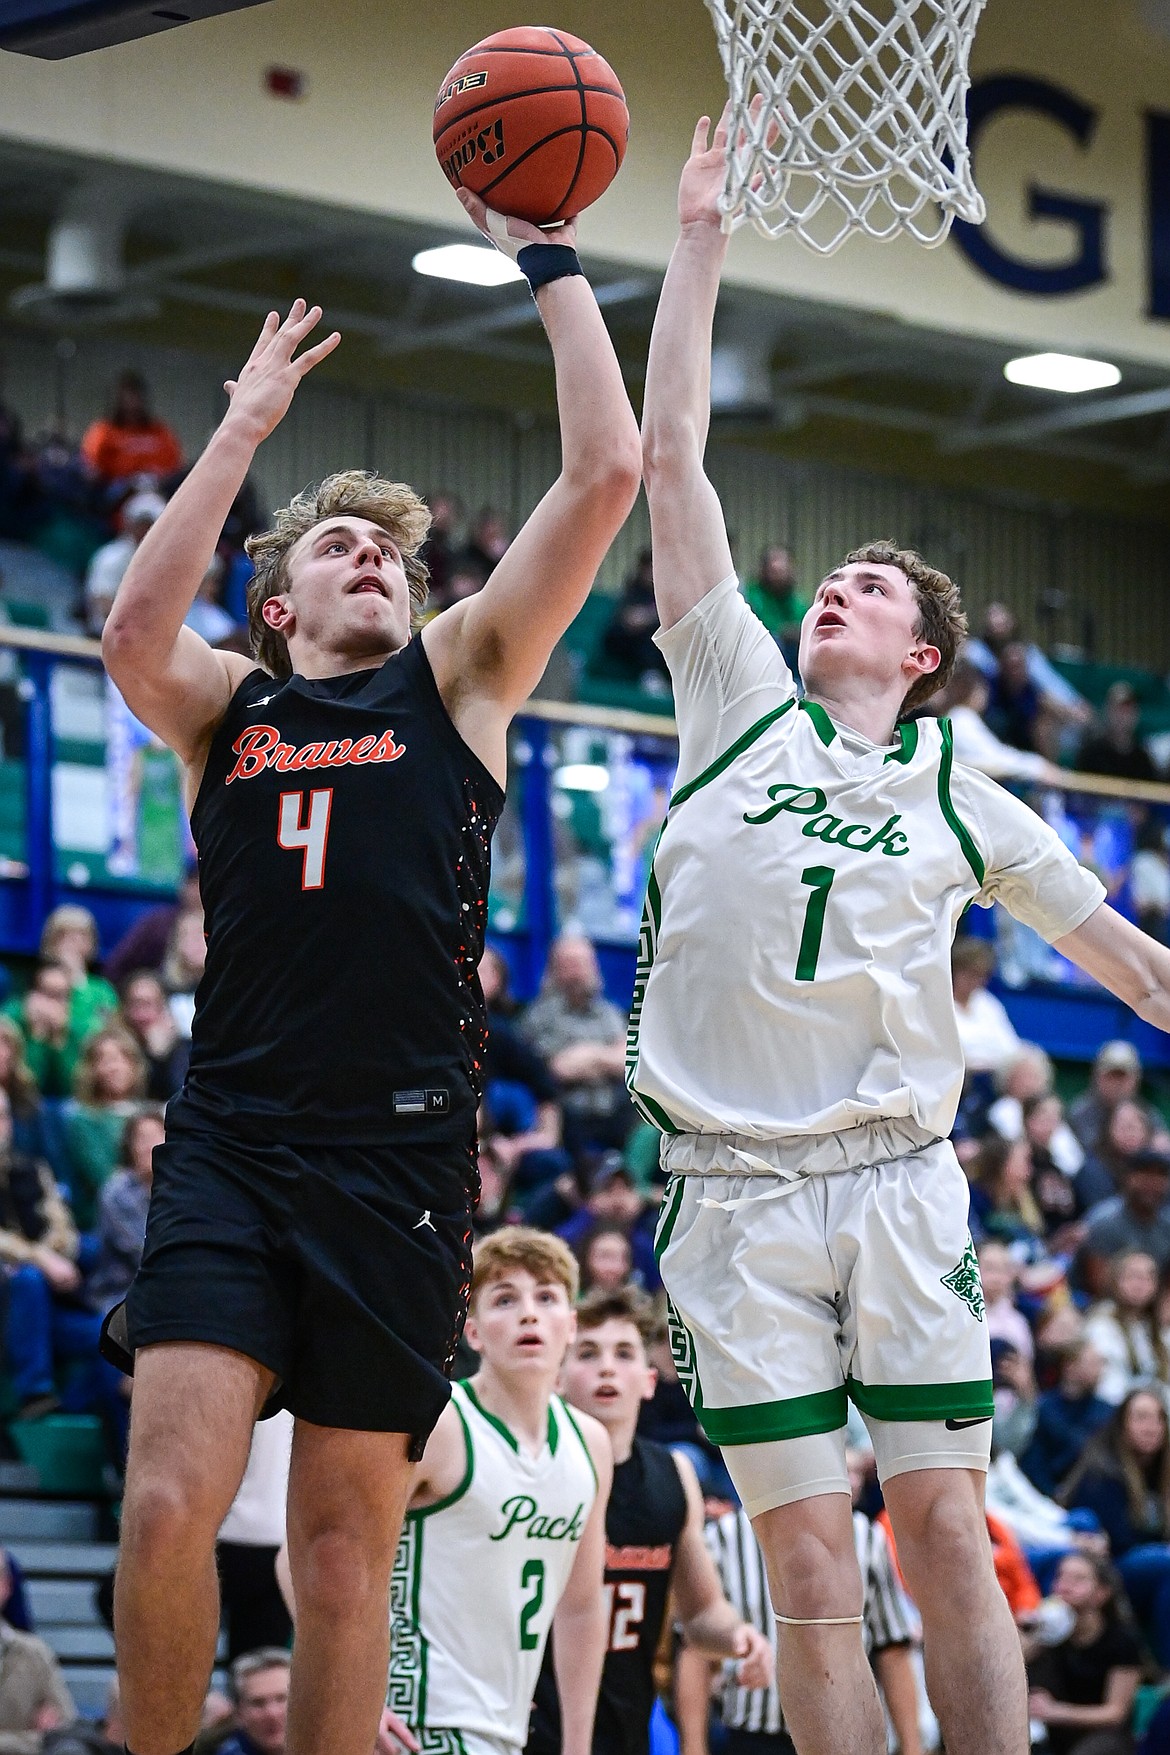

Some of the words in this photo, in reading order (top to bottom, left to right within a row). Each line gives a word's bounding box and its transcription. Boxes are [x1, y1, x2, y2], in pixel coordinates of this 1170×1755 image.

[434, 71, 488, 113] ELIT
[225, 724, 406, 785] Braves
[277, 787, 334, 891] 4
[743, 783, 910, 856] Pack
[795, 865, 835, 981] 1
[433, 1095, 443, 1107] M
[489, 1495, 584, 1541] Pack
[520, 1559, 545, 1650] 2
